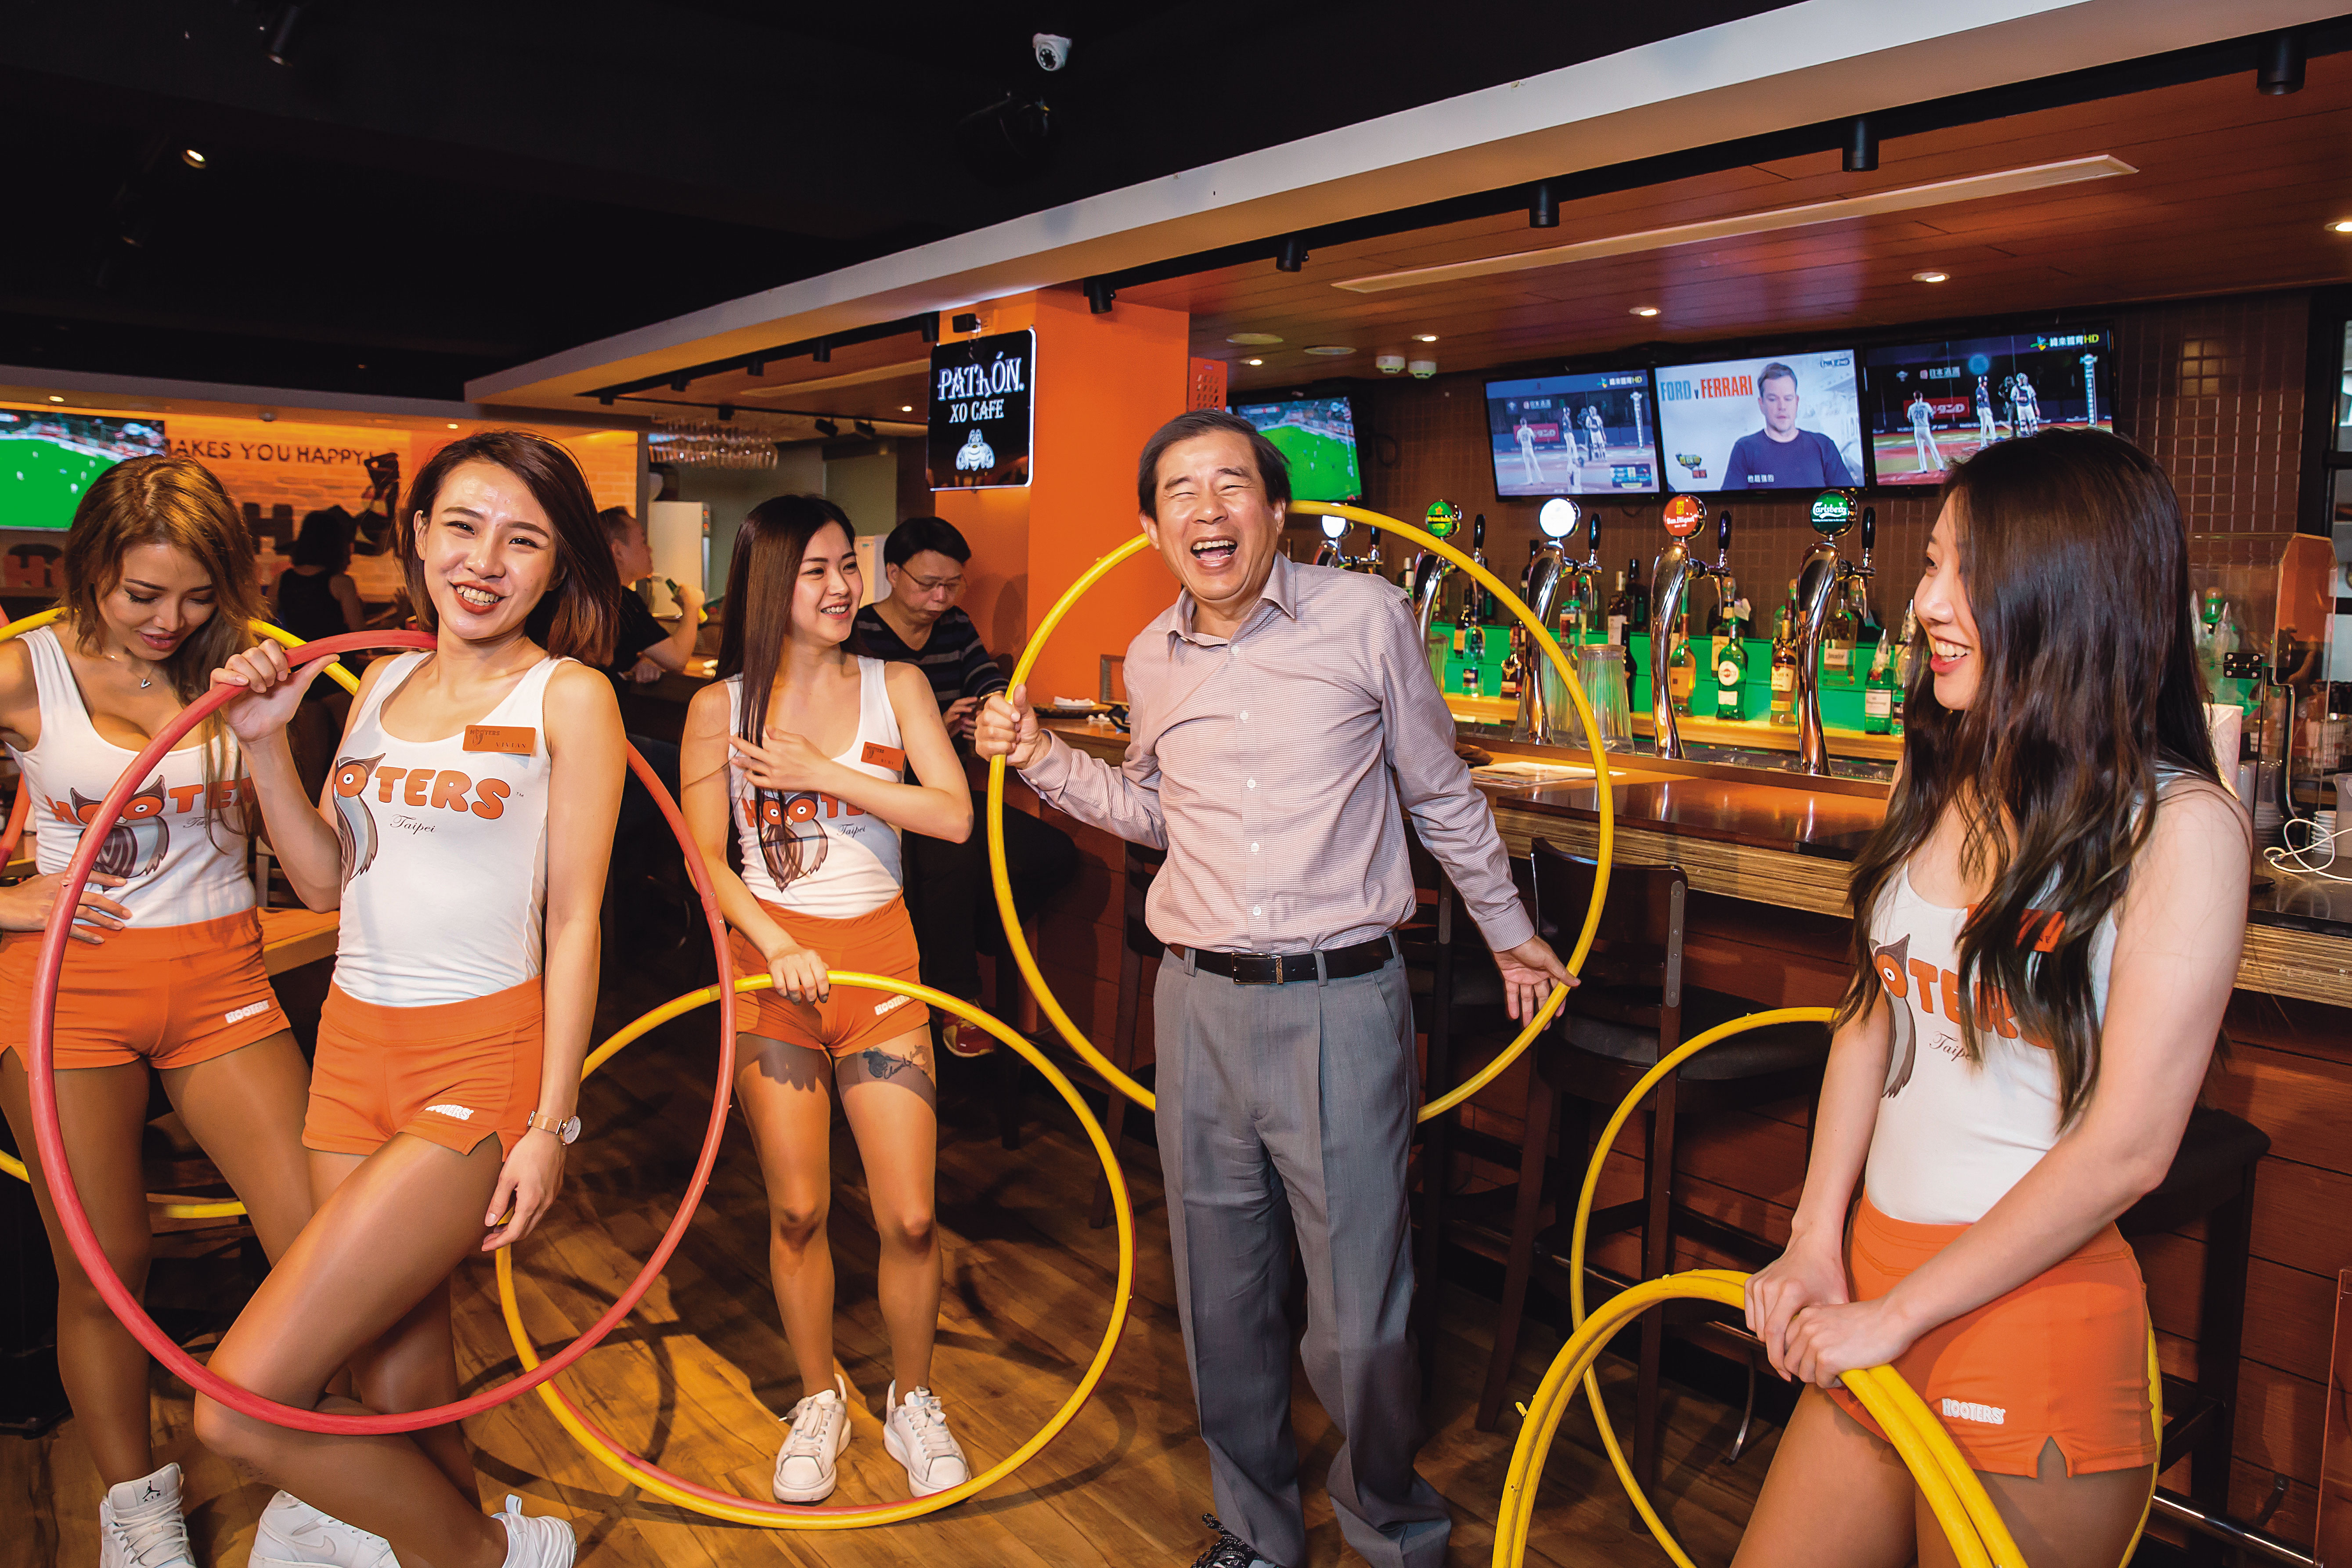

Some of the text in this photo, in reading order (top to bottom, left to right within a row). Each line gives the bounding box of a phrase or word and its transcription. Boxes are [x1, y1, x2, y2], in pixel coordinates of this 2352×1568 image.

[1661, 380, 1691, 401] FORD
[1700, 375, 1753, 398] FERRARI
[949, 399, 1004, 423] XO CAFE
[166, 440, 364, 465] AKES YOU HAPPY
[1813, 502, 1847, 519] Carlsberg
[335, 764, 511, 820] OTERS
[390, 814, 436, 835] Taipei
[837, 822, 866, 838] Taipei
[1929, 1031, 1972, 1062] Taipe
[1941, 1398, 2006, 1424] HOOTERS
[144, 1492, 161, 1502] AIR
